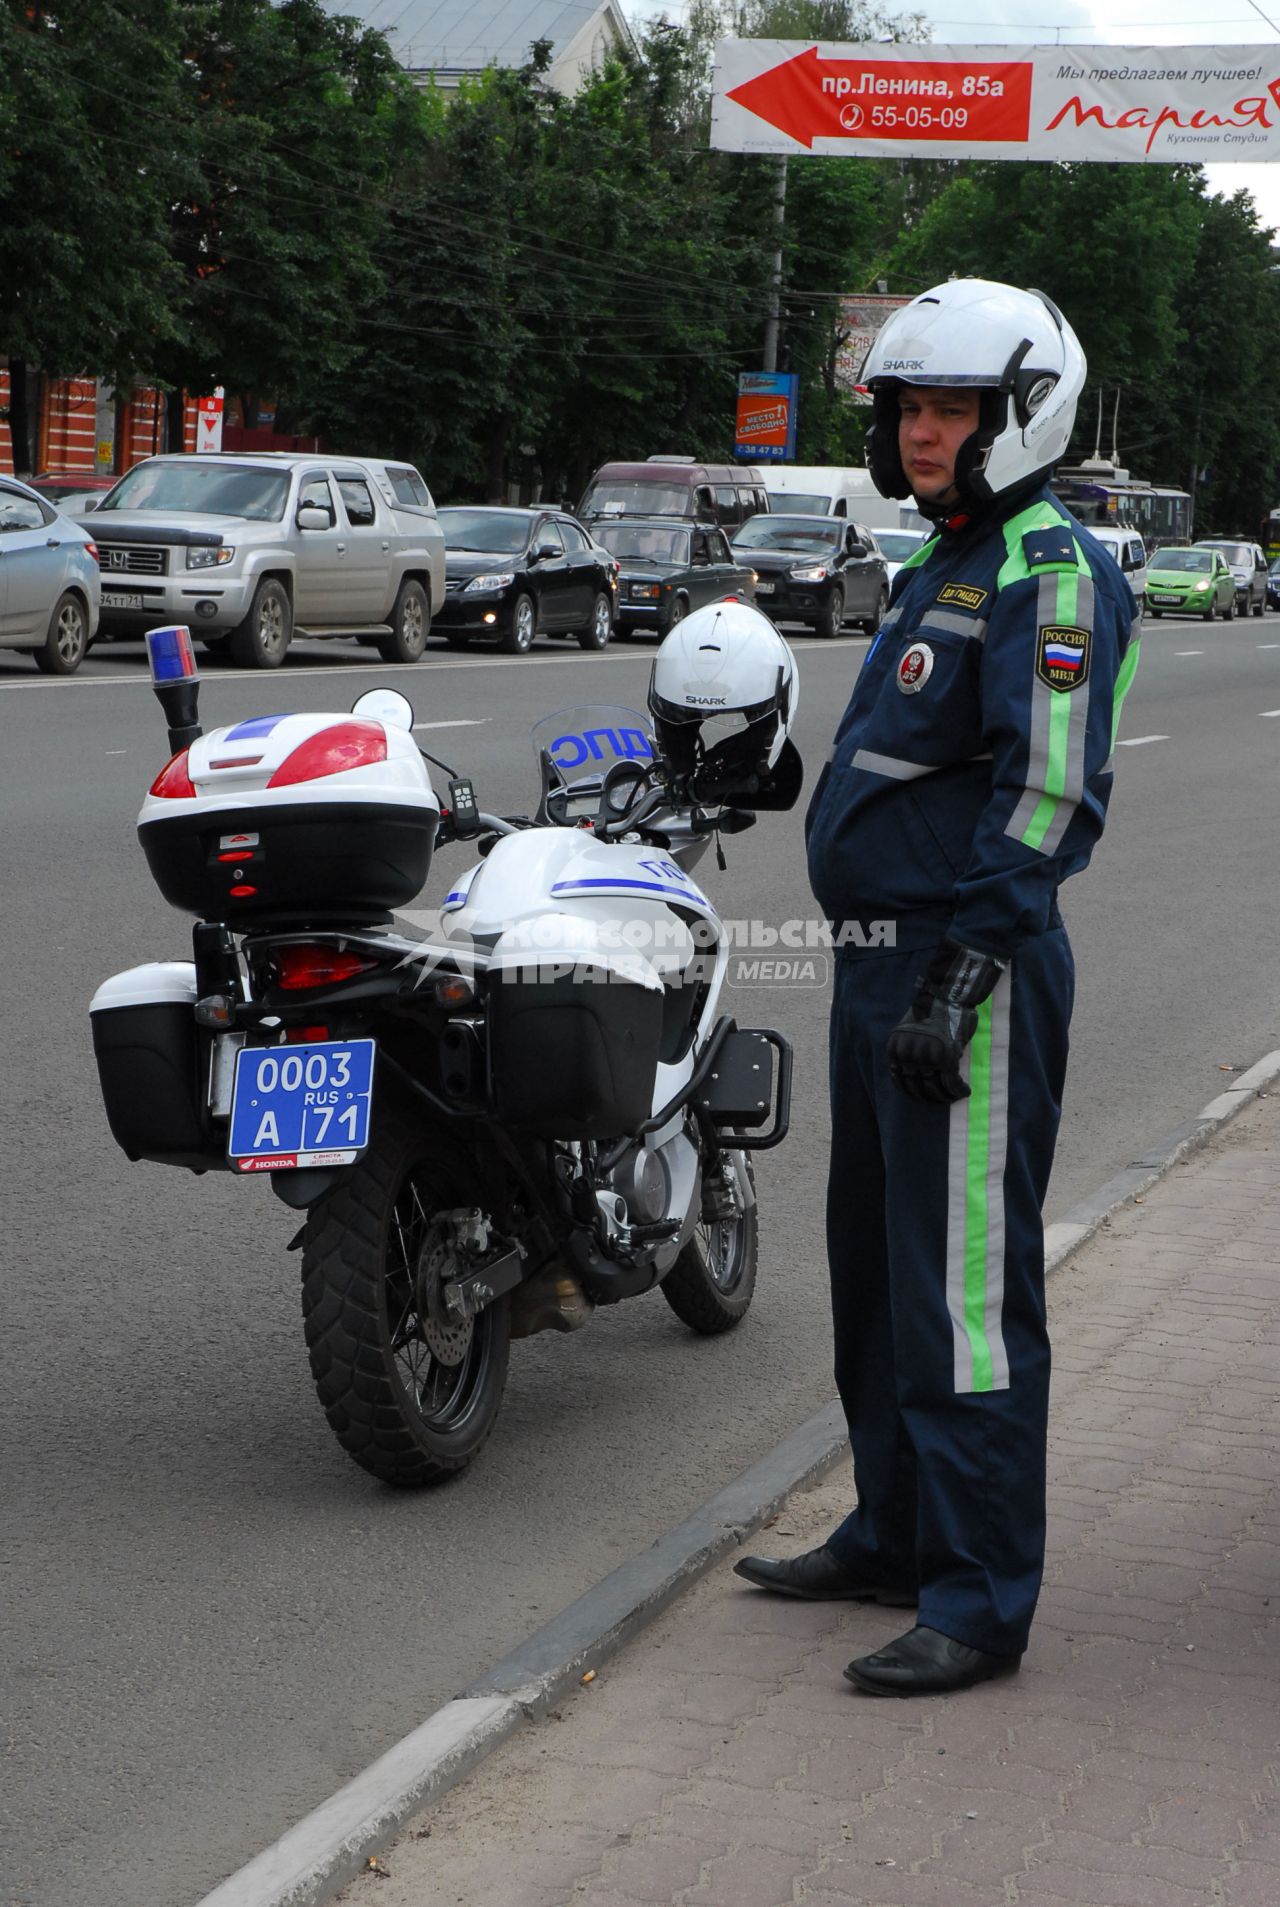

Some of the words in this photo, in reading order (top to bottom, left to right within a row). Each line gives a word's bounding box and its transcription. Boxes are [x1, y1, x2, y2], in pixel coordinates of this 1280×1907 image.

[1056, 65, 1084, 79] Мы
[1089, 66, 1188, 82] предлагаем
[1191, 67, 1263, 83] лучшее!
[821, 73, 955, 98] пр.Ленина,
[961, 76, 1005, 97] 85а
[871, 106, 968, 128] 55-05-09
[1166, 133, 1221, 144] Кухонная
[1223, 133, 1269, 145] Студия
[883, 360, 925, 370] SHARK
[746, 413, 775, 424] МЕСТО
[739, 418, 785, 434] СВОБОДНО
[744, 446, 756, 454] 38
[1045, 631, 1086, 645] РОССИЯ
[1049, 669, 1075, 682] МВД
[685, 695, 727, 706] SHARK
[256, 1051, 352, 1093] 0003
[304, 1091, 339, 1106] RUS
[253, 1110, 280, 1148] А
[312, 1104, 358, 1144] 71
[255, 1160, 295, 1168] HONDA
